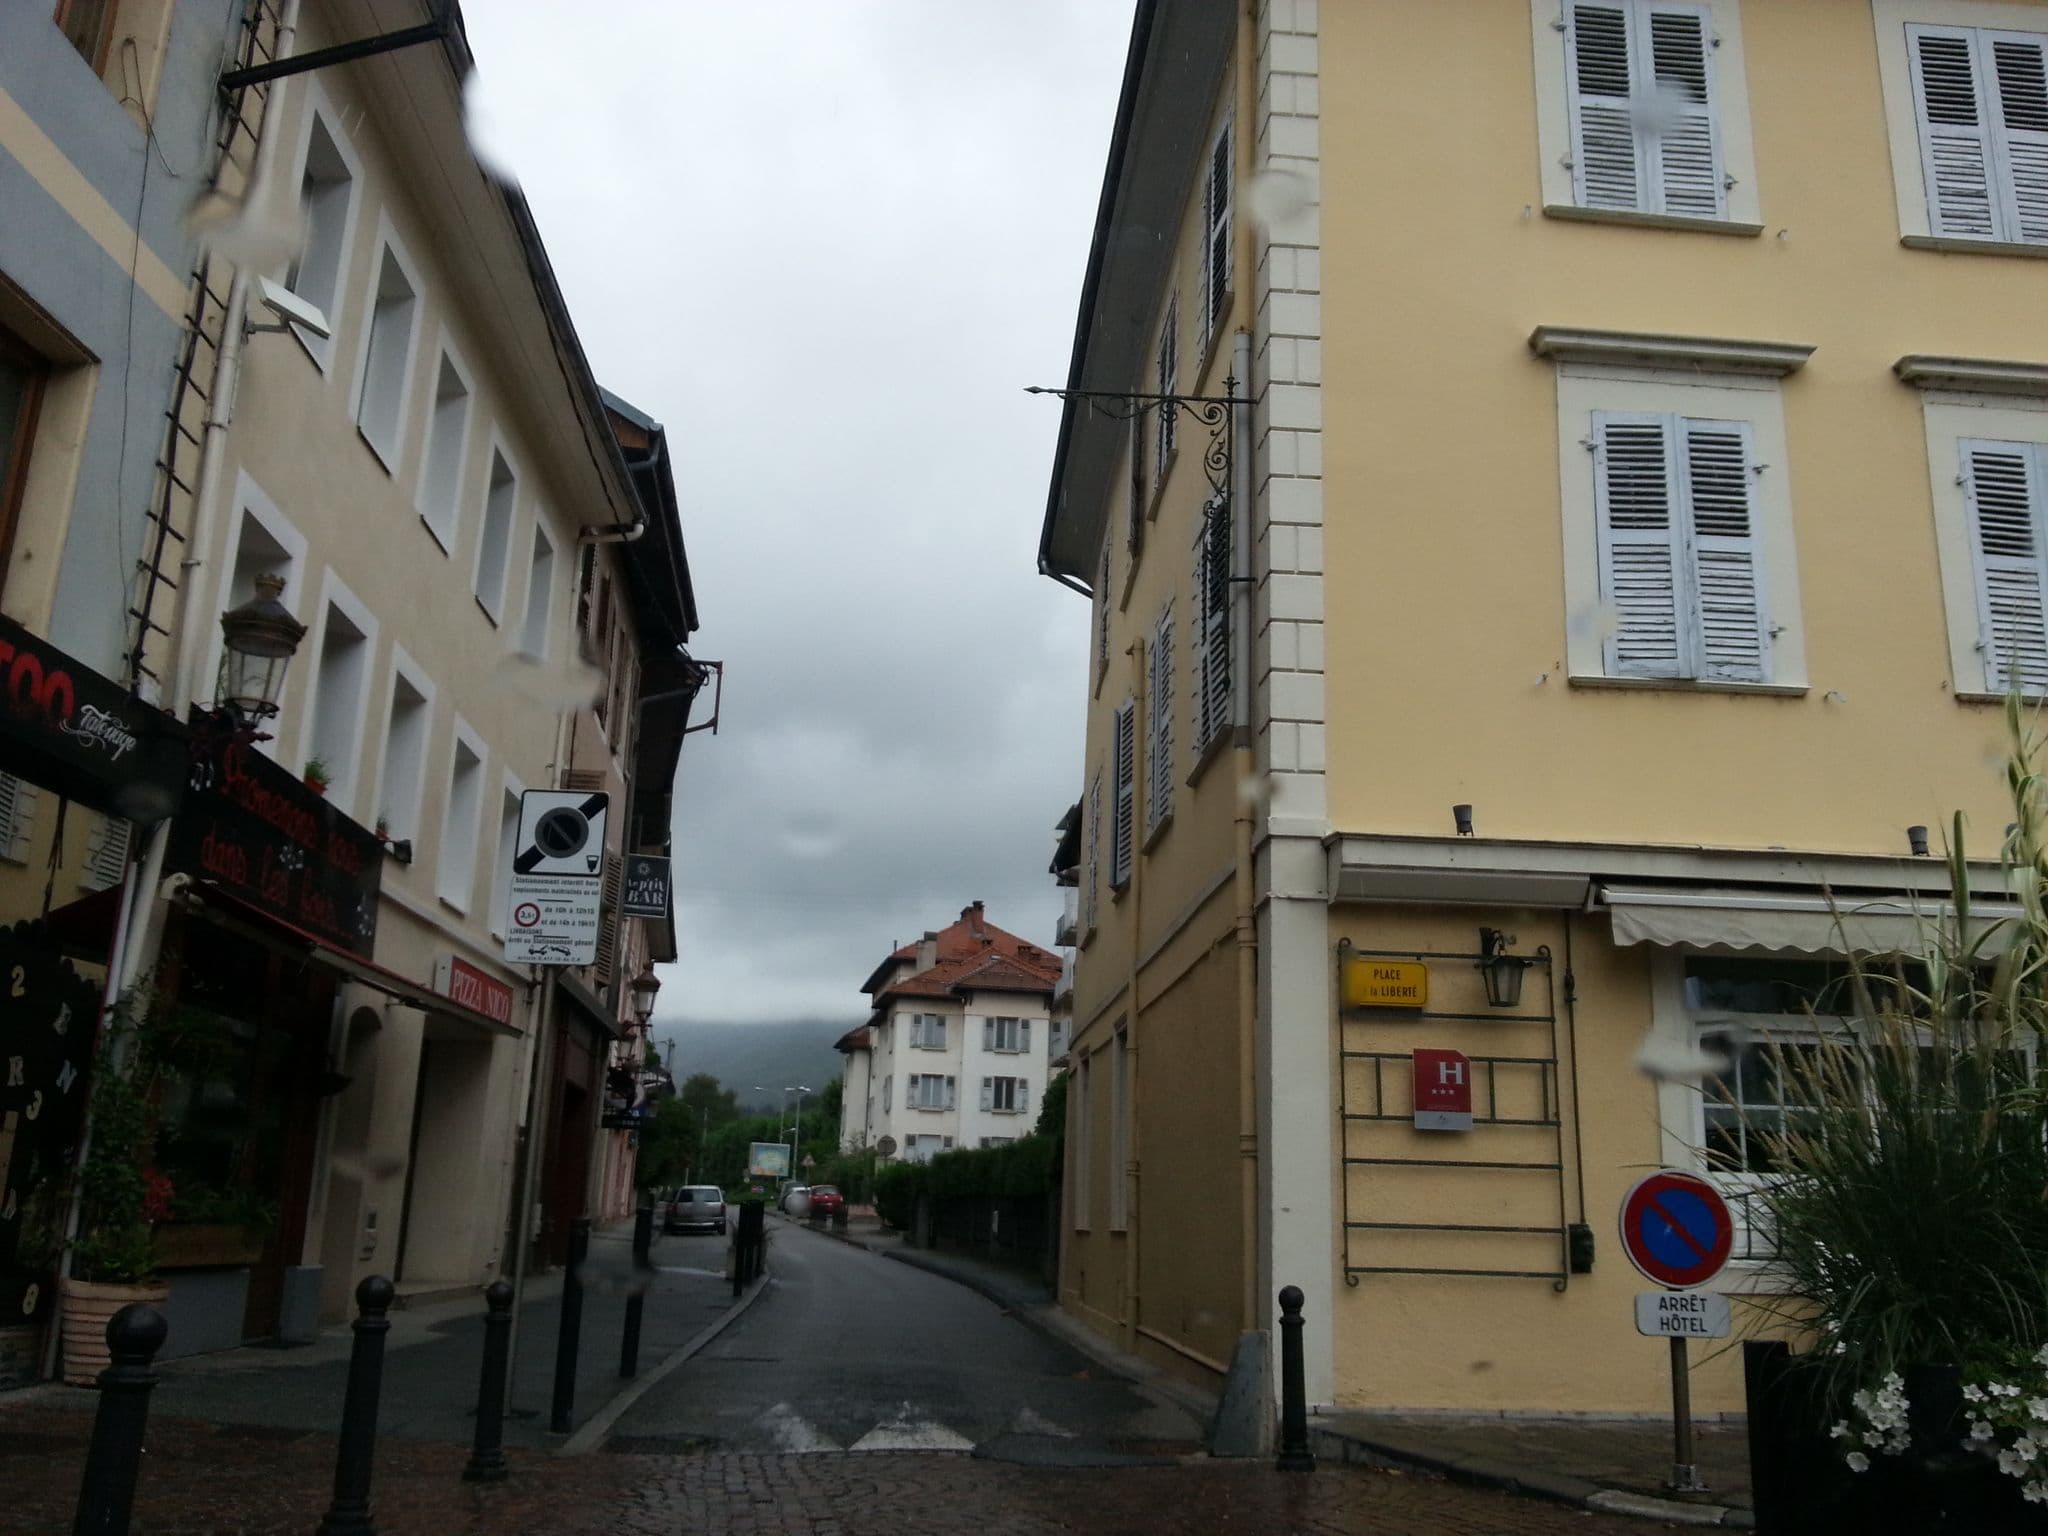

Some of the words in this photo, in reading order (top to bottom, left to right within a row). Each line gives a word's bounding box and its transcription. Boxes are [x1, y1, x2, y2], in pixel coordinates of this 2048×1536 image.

[628, 889, 664, 905] BAR
[1373, 968, 1401, 981] PLACE
[452, 968, 482, 1011] PIZZA
[1381, 984, 1417, 998] LIBERTÉ
[1439, 1061, 1464, 1085] H
[1658, 1294, 1708, 1313] ARRÊT
[1660, 1314, 1708, 1333] HÔTEL
